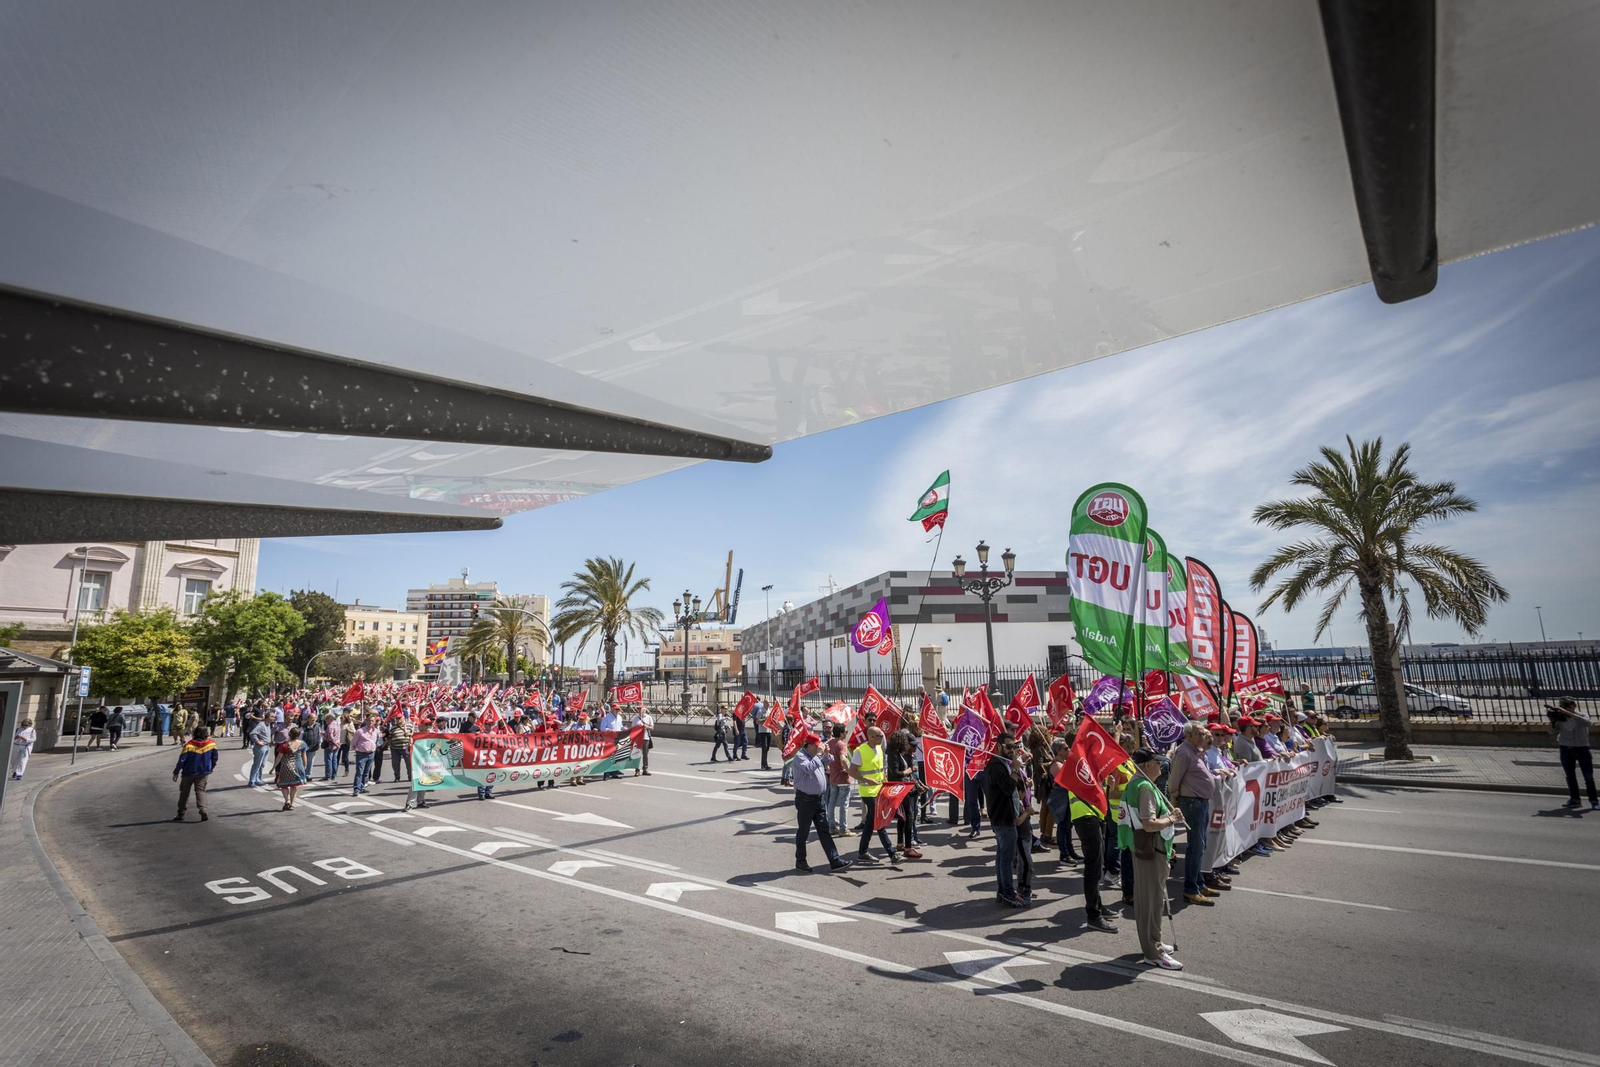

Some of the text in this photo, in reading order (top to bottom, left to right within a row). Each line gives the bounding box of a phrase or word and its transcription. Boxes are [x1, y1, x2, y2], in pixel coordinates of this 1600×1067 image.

[474, 732, 604, 749] DEFENDER LAS PENSIONES
[502, 747, 536, 764] COSA
[541, 747, 558, 762] DE
[932, 750, 948, 776] UGT
[1246, 779, 1260, 821] 1
[204, 857, 385, 904] BUS
